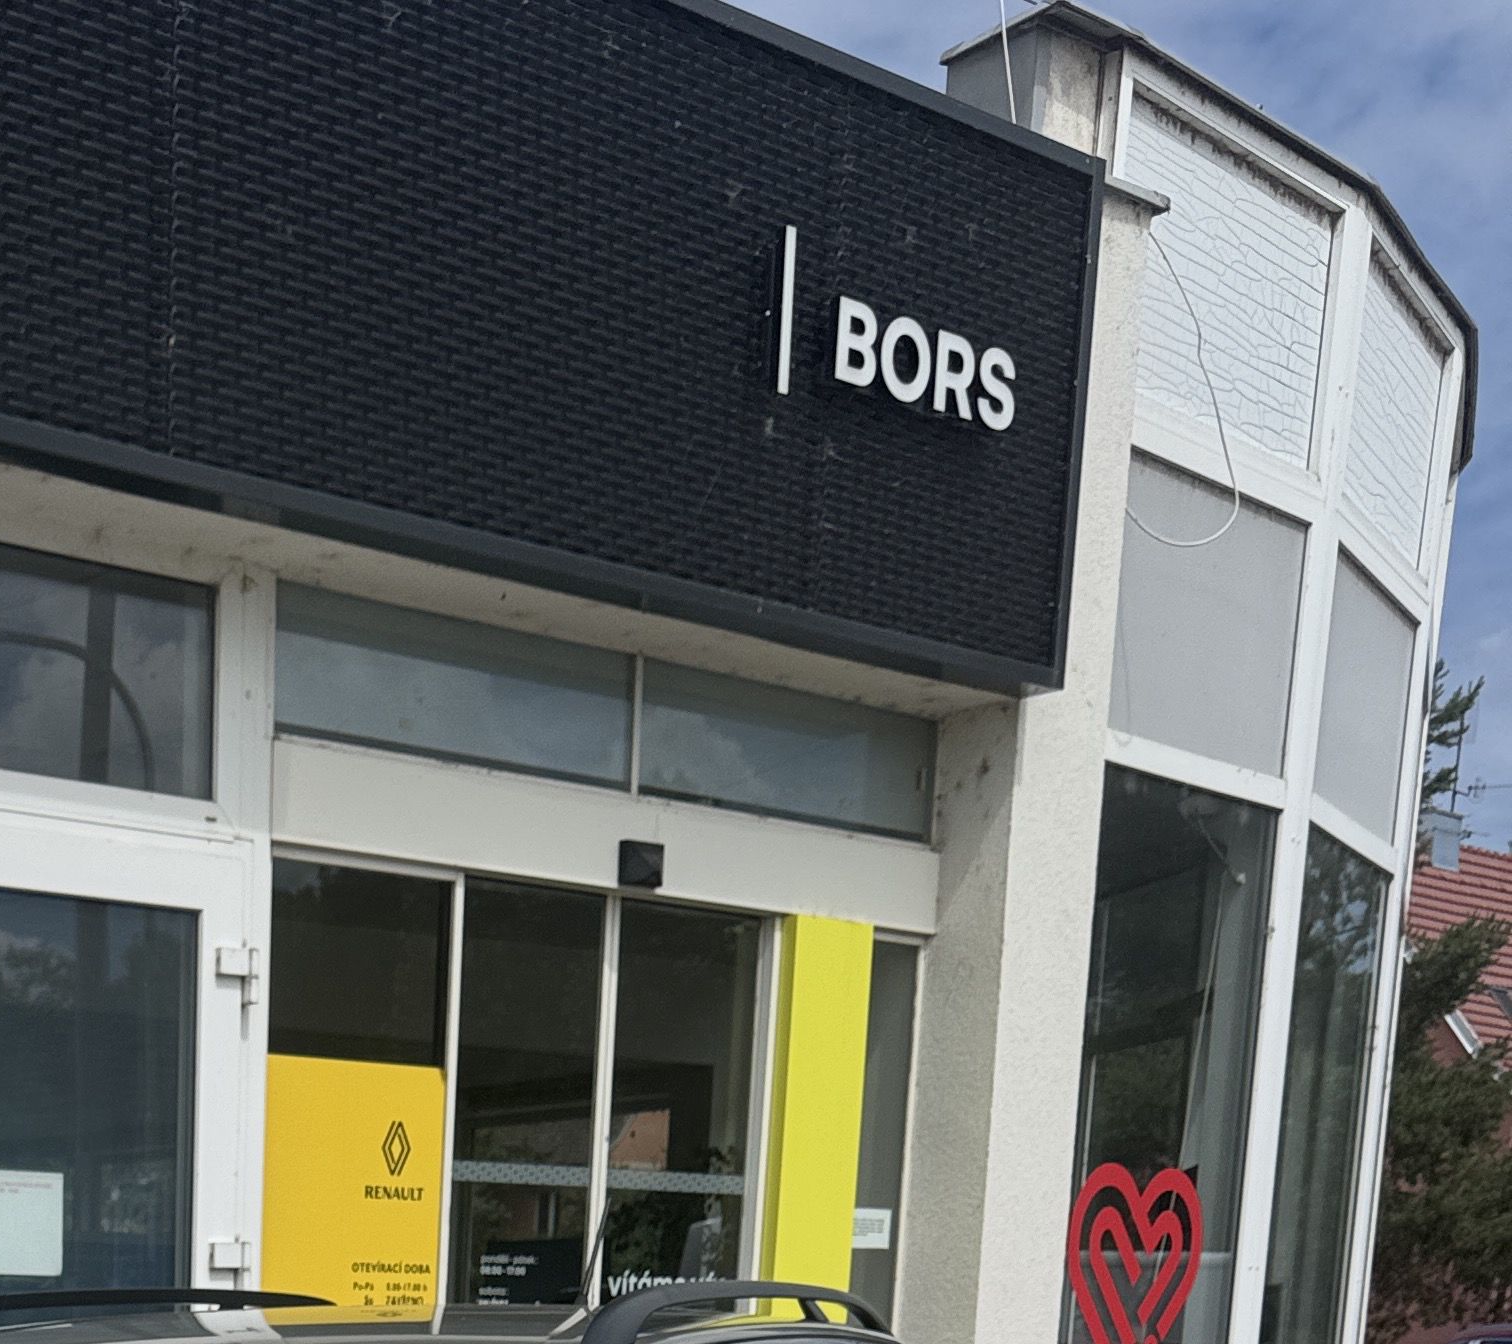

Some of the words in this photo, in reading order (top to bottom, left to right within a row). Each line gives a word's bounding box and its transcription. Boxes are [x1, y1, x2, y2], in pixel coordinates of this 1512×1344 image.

[834, 295, 1016, 432] BORS
[364, 1185, 424, 1201] RENAULT
[404, 1264, 430, 1274] DOBA
[607, 1269, 686, 1297] vítá
